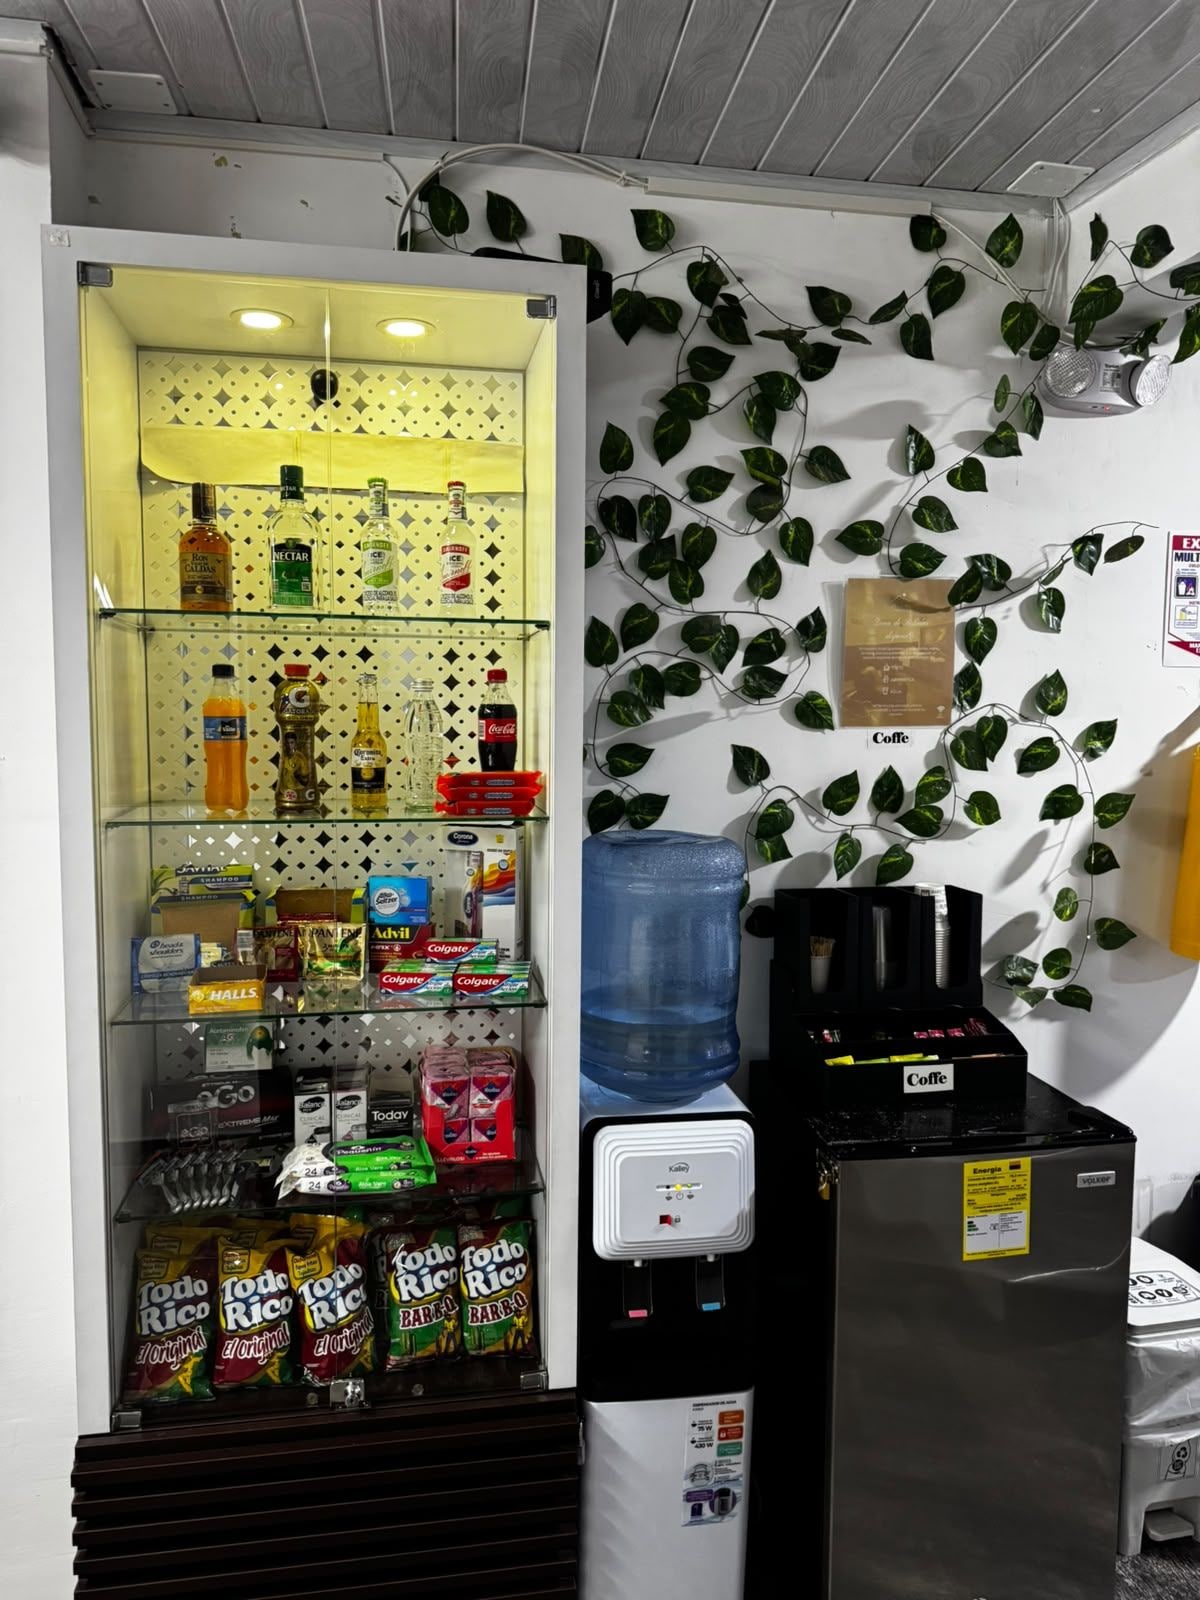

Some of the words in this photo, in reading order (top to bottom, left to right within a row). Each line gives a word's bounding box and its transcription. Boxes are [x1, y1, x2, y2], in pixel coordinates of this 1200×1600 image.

[273, 551, 309, 561] NECTAR
[488, 723, 515, 734] Coca-Cola
[872, 731, 909, 744] Coffe
[373, 927, 410, 939] Advil
[427, 944, 469, 955] Colgate
[382, 974, 426, 986] Colgate
[457, 976, 500, 988] Colgate
[210, 988, 257, 1000] HALLS
[907, 1071, 947, 1087] Coffe
[371, 1110, 409, 1121] Today
[305, 1167, 318, 1177] 24
[669, 1164, 690, 1173] Kalley
[308, 1181, 321, 1190] 24
[461, 1239, 525, 1273] Todo
[221, 1269, 289, 1304] Todo
[298, 1263, 363, 1304] Todo
[398, 1265, 458, 1301] Rico
[464, 1263, 527, 1299] Rico
[139, 1275, 209, 1309] Todo
[139, 1301, 210, 1336] Rico
[224, 1296, 293, 1331] Rico
[330, 1306, 374, 1355] Original
[149, 1325, 207, 1370] Original
[238, 1321, 291, 1365] Original
